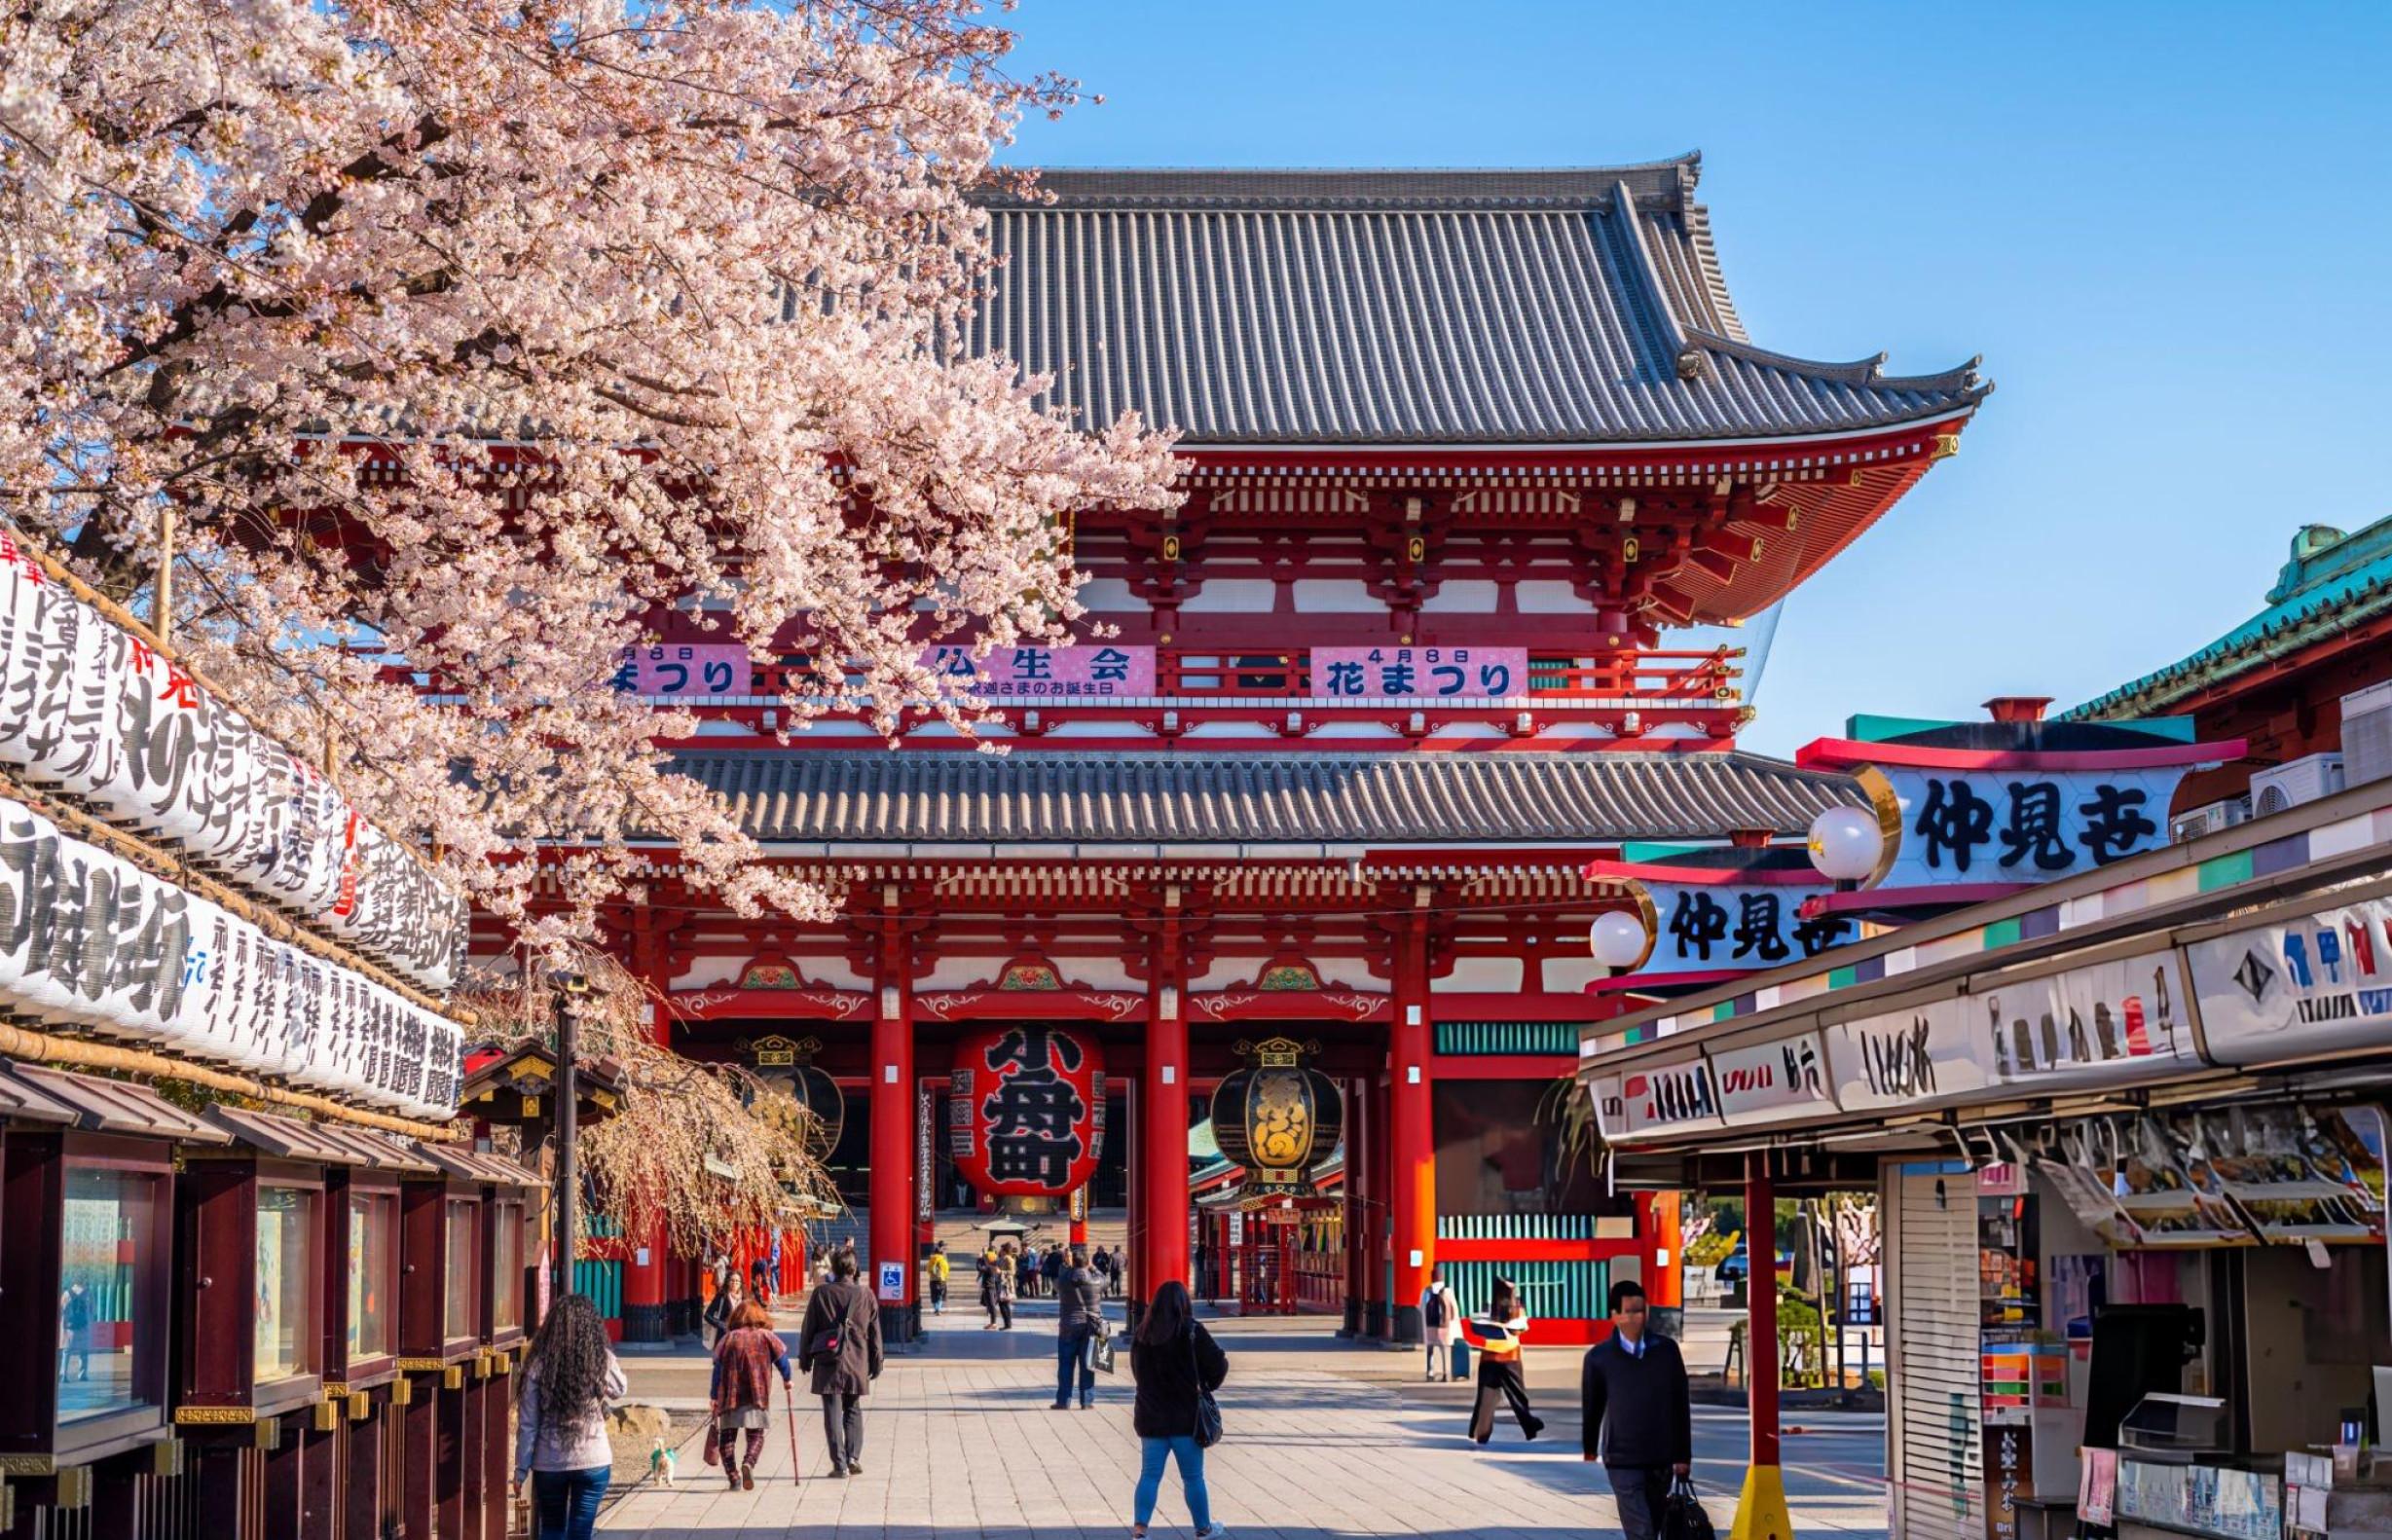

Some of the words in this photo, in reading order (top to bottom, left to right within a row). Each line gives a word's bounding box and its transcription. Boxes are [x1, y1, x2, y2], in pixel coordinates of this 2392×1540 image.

[622, 646, 693, 660] 月8日
[936, 647, 1130, 680] 仏生会
[1368, 648, 1468, 663] 4月8日
[955, 681, 1114, 695] 釈迦さまのお誕生日
[1327, 661, 1509, 696] 花まつり
[1916, 779, 2157, 872] 仲見世
[1669, 891, 1852, 961] 仲見世
[981, 1022, 1088, 1190] 小舟町
